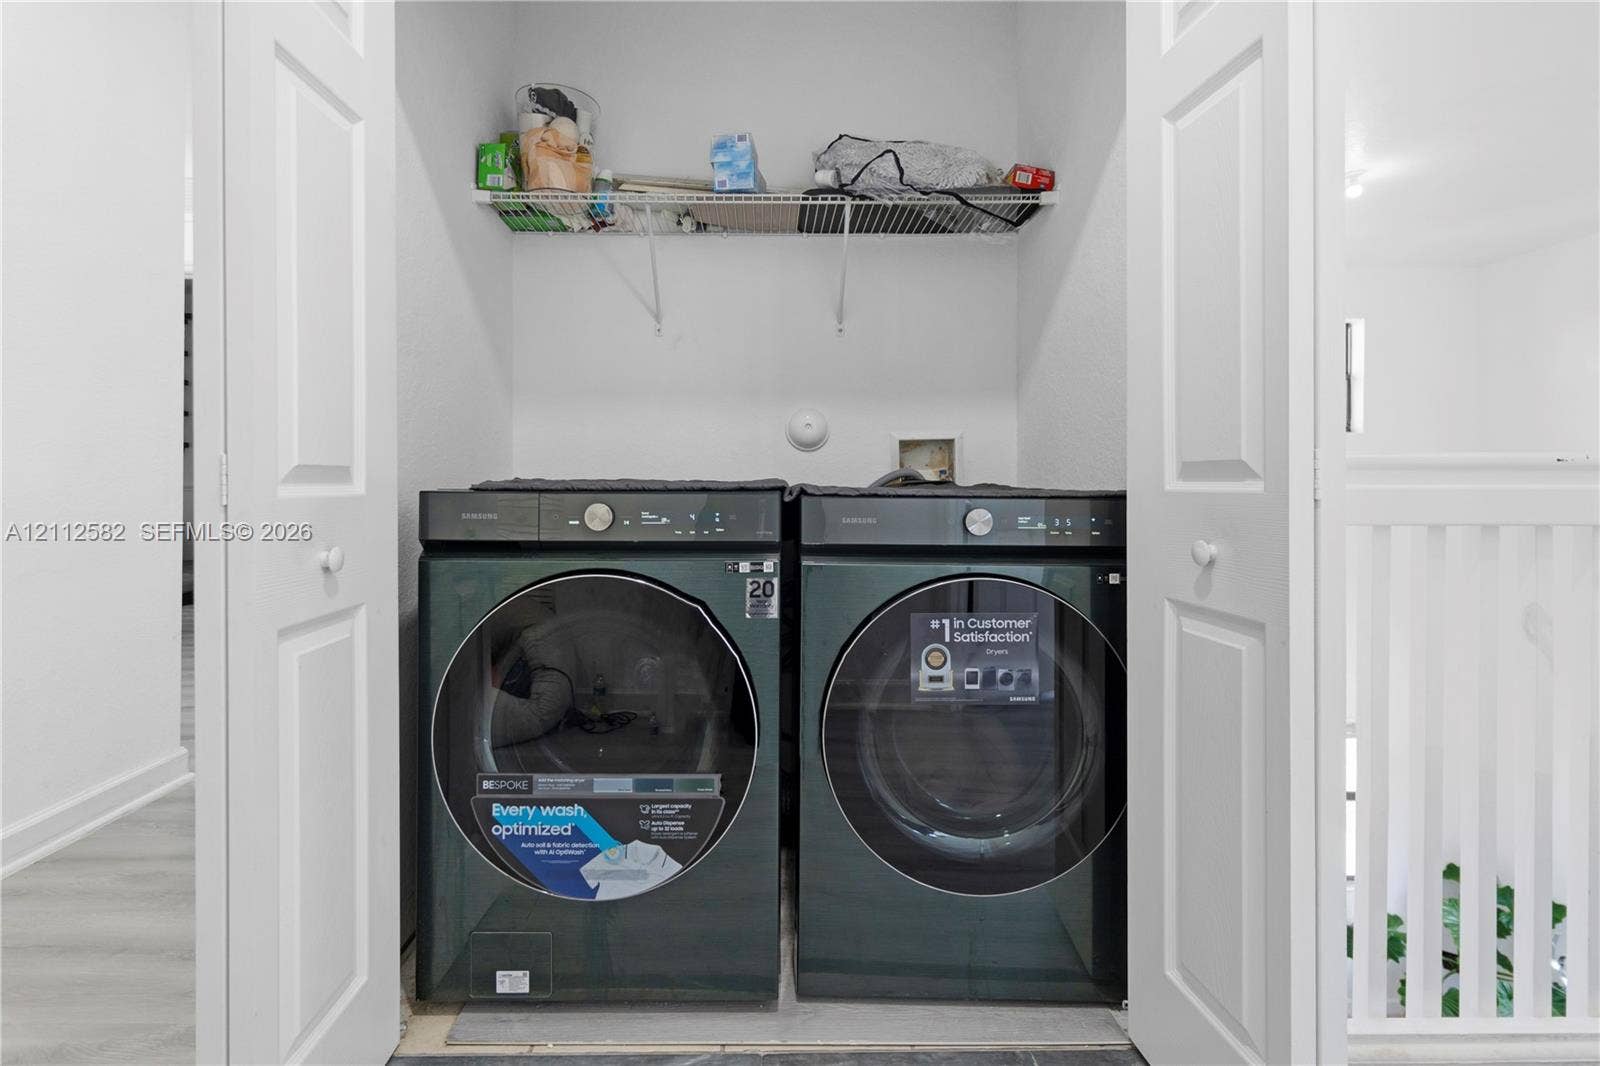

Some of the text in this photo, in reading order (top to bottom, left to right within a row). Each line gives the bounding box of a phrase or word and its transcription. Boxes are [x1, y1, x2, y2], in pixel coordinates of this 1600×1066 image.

[461, 512, 498, 520] SAMSUNG
[749, 580, 775, 598] 20
[930, 617, 1032, 642] #1 in Customer
[986, 648, 1009, 656] Dryers
[482, 780, 529, 790] BESPOKE
[670, 803, 692, 811] capacity
[491, 803, 588, 821] Every wash,
[520, 841, 600, 849] Auto soil & fabric detection
[534, 848, 548, 856] with
